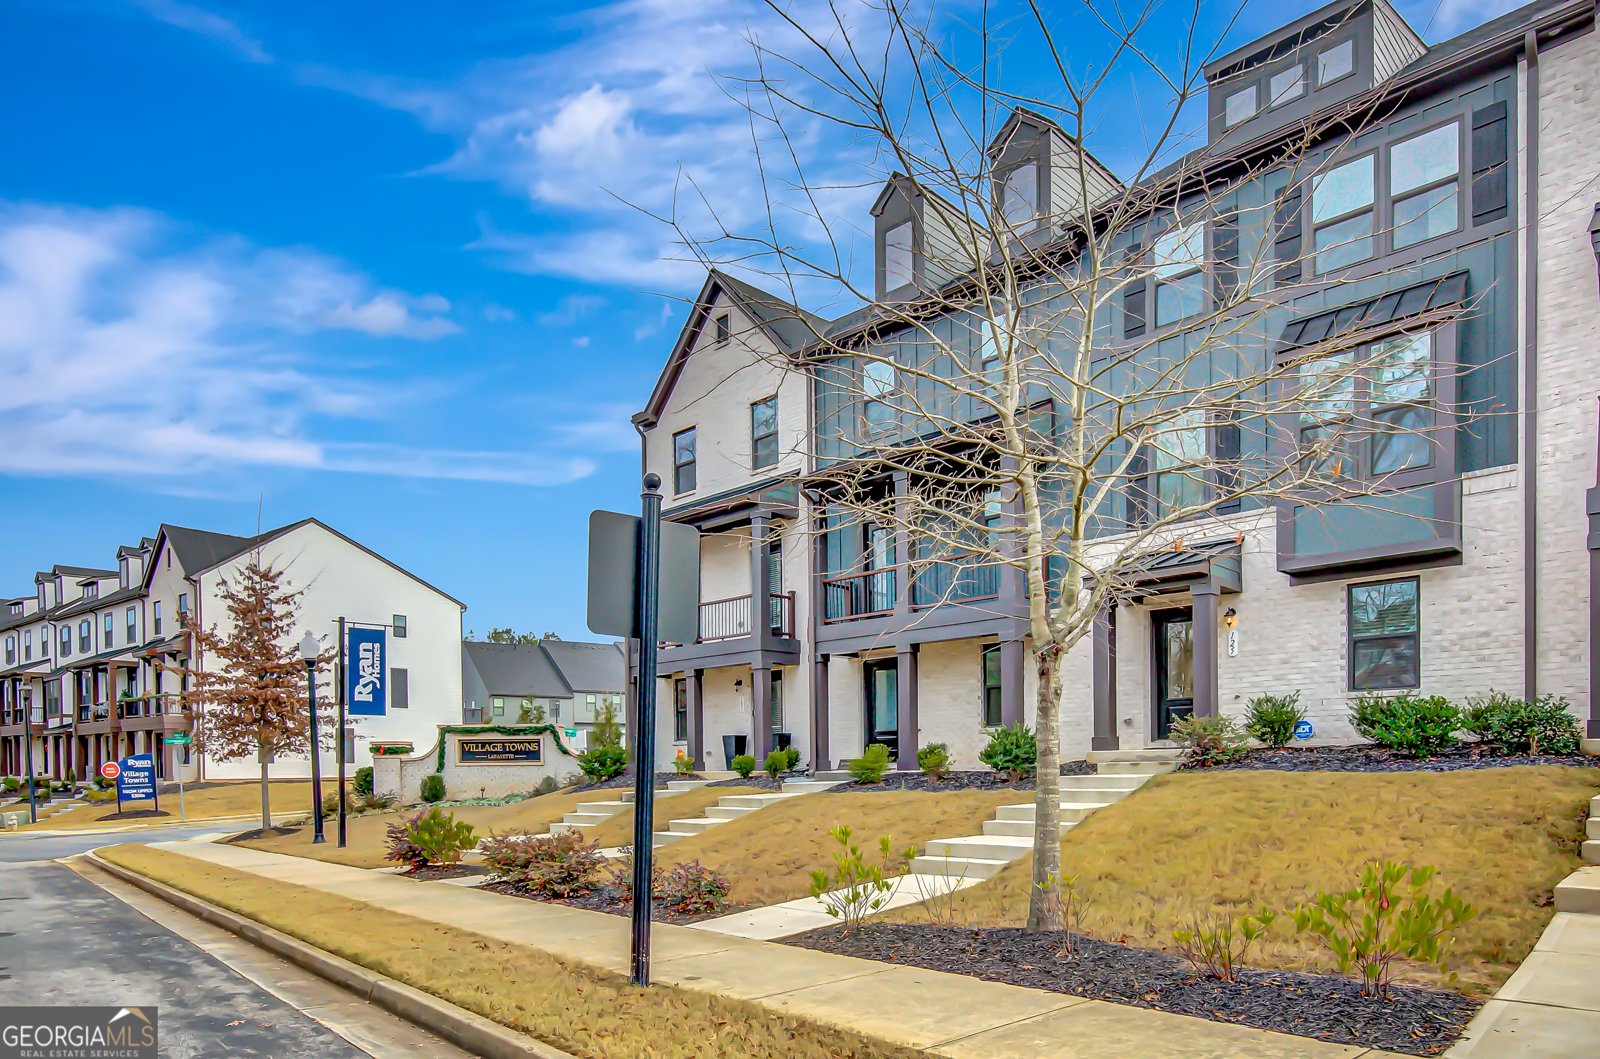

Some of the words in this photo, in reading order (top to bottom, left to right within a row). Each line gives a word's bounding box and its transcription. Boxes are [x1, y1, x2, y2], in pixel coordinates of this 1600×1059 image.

[372, 642, 381, 678] Homes
[354, 642, 380, 702] Ryan
[1296, 725, 1311, 733] ADT
[463, 743, 503, 752] VILLAGE
[504, 742, 539, 751] TOWNS
[127, 759, 151, 768] Ryan
